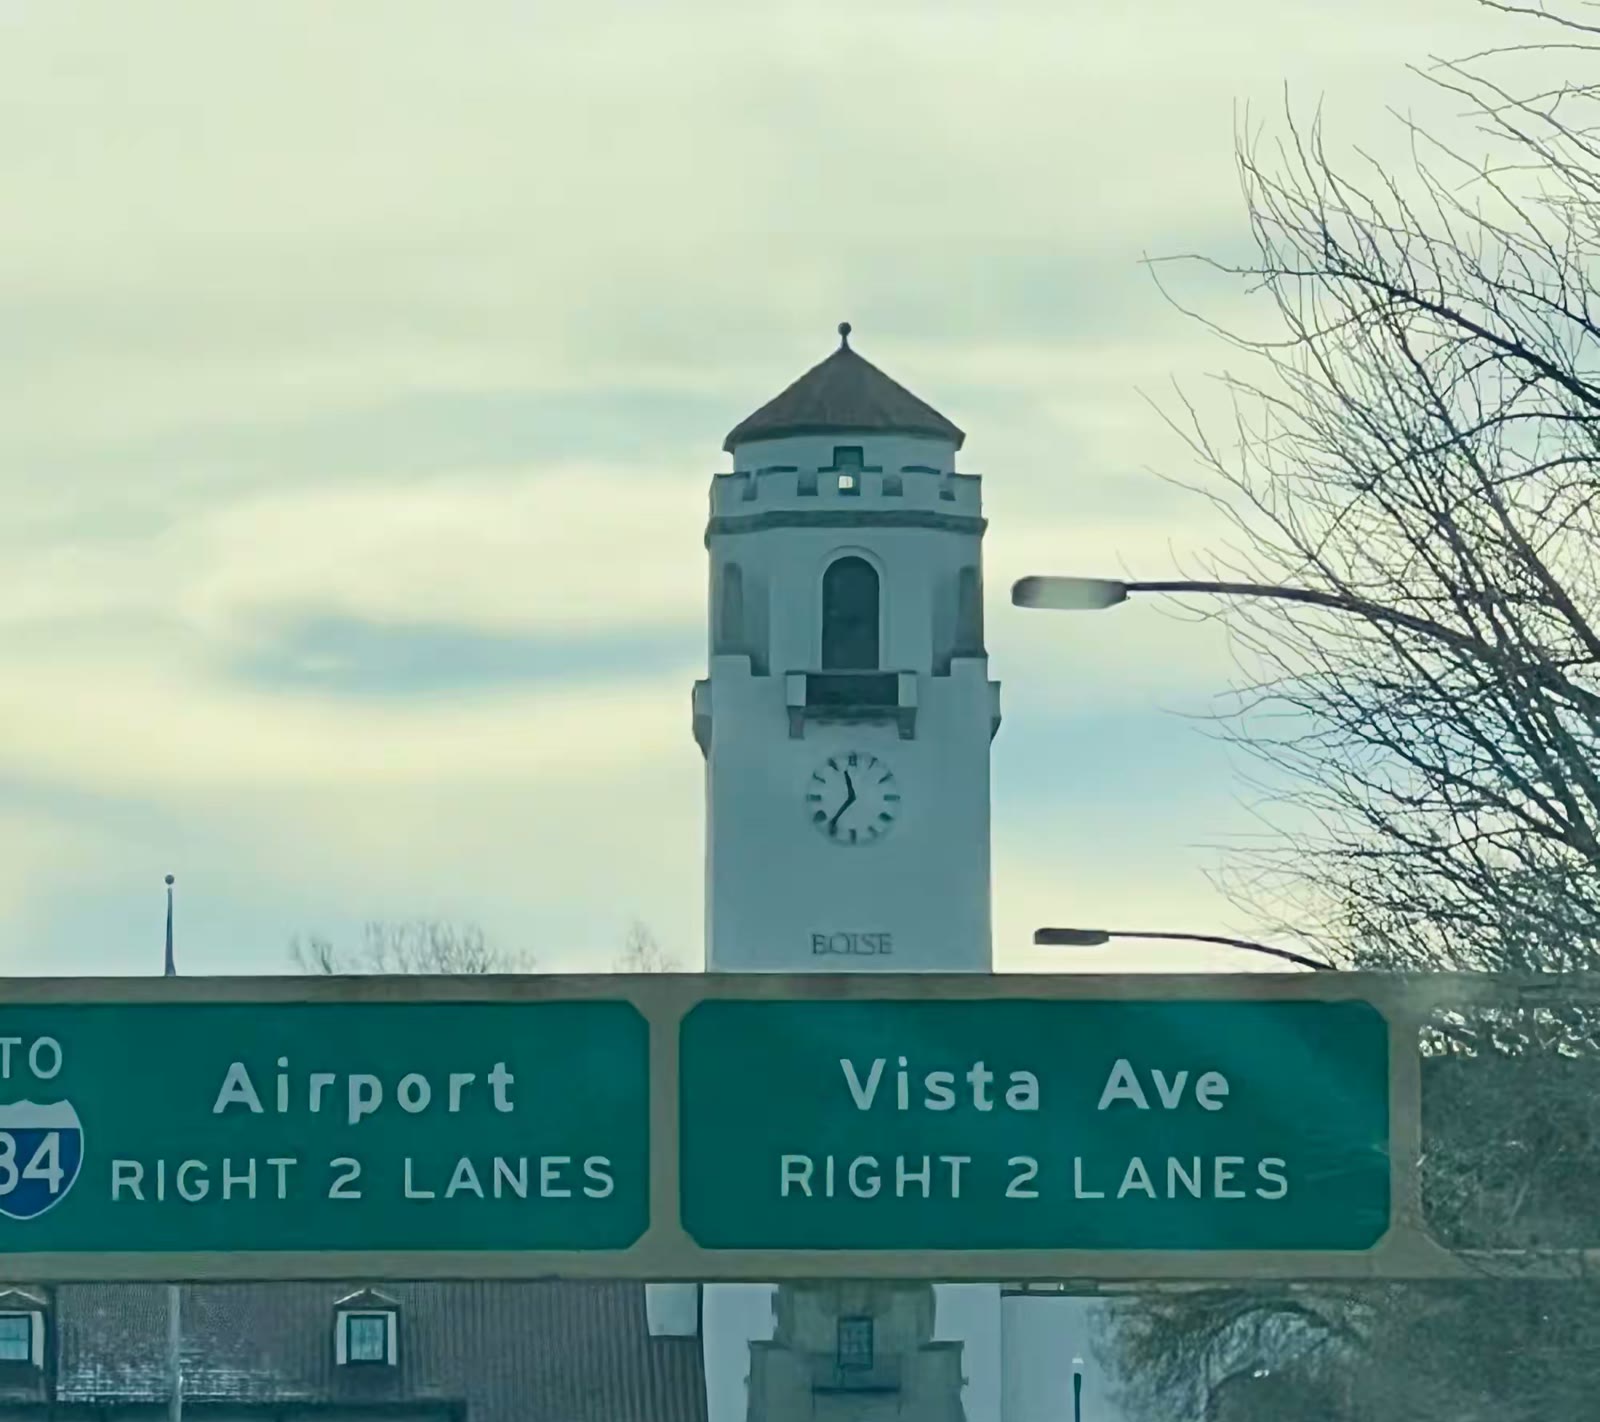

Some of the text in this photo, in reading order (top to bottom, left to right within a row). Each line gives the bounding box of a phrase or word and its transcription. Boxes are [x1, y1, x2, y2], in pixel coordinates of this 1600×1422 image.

[812, 932, 893, 955] BOISE
[0, 1036, 63, 1079] TO
[212, 1056, 515, 1125] Airport
[839, 1056, 1230, 1111] Vista Ave
[111, 1155, 615, 1201] RIGHT 2 LANES
[780, 1154, 1289, 1200] RIGHT 2 LANES
